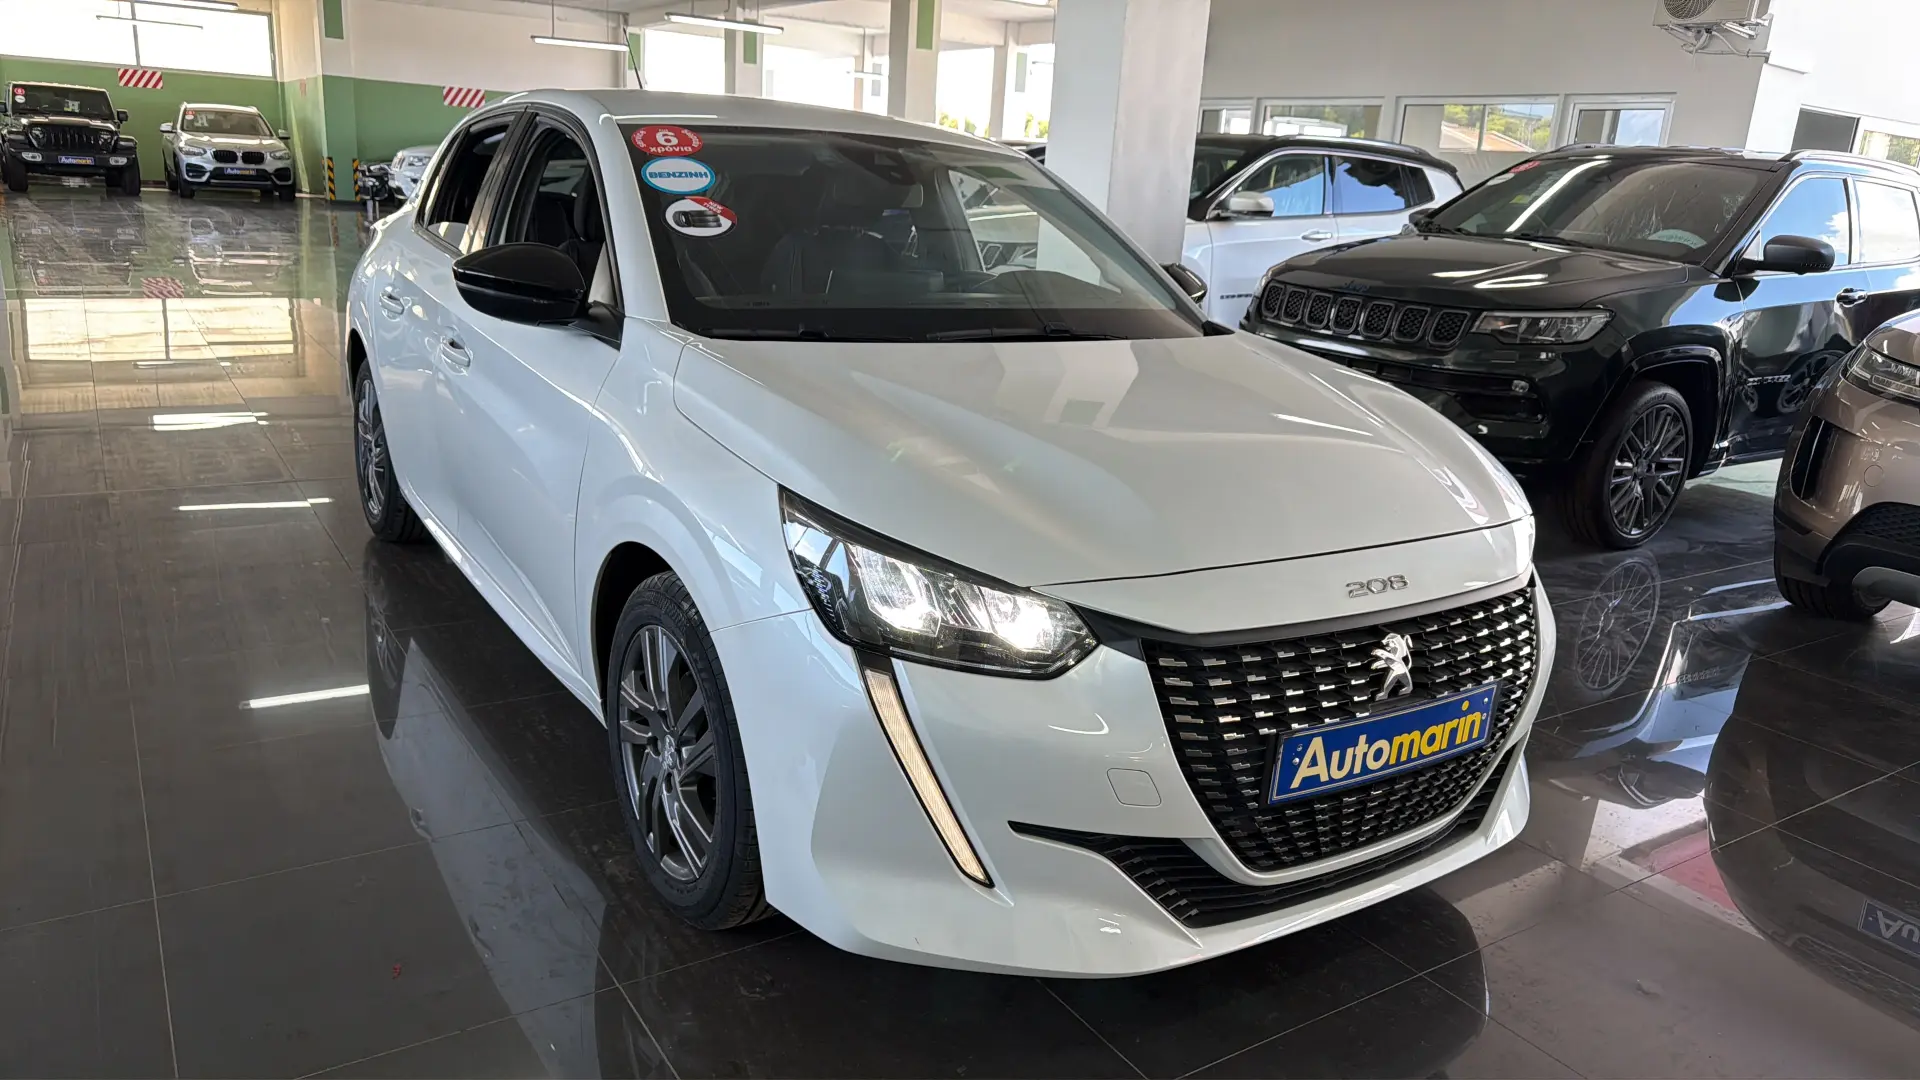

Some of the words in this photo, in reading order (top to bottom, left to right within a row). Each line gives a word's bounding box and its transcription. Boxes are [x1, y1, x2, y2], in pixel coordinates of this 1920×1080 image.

[656, 131, 679, 146] 6
[649, 146, 692, 154] χρόνια
[1345, 574, 1410, 599] 208
[1290, 700, 1483, 790] Automarin
